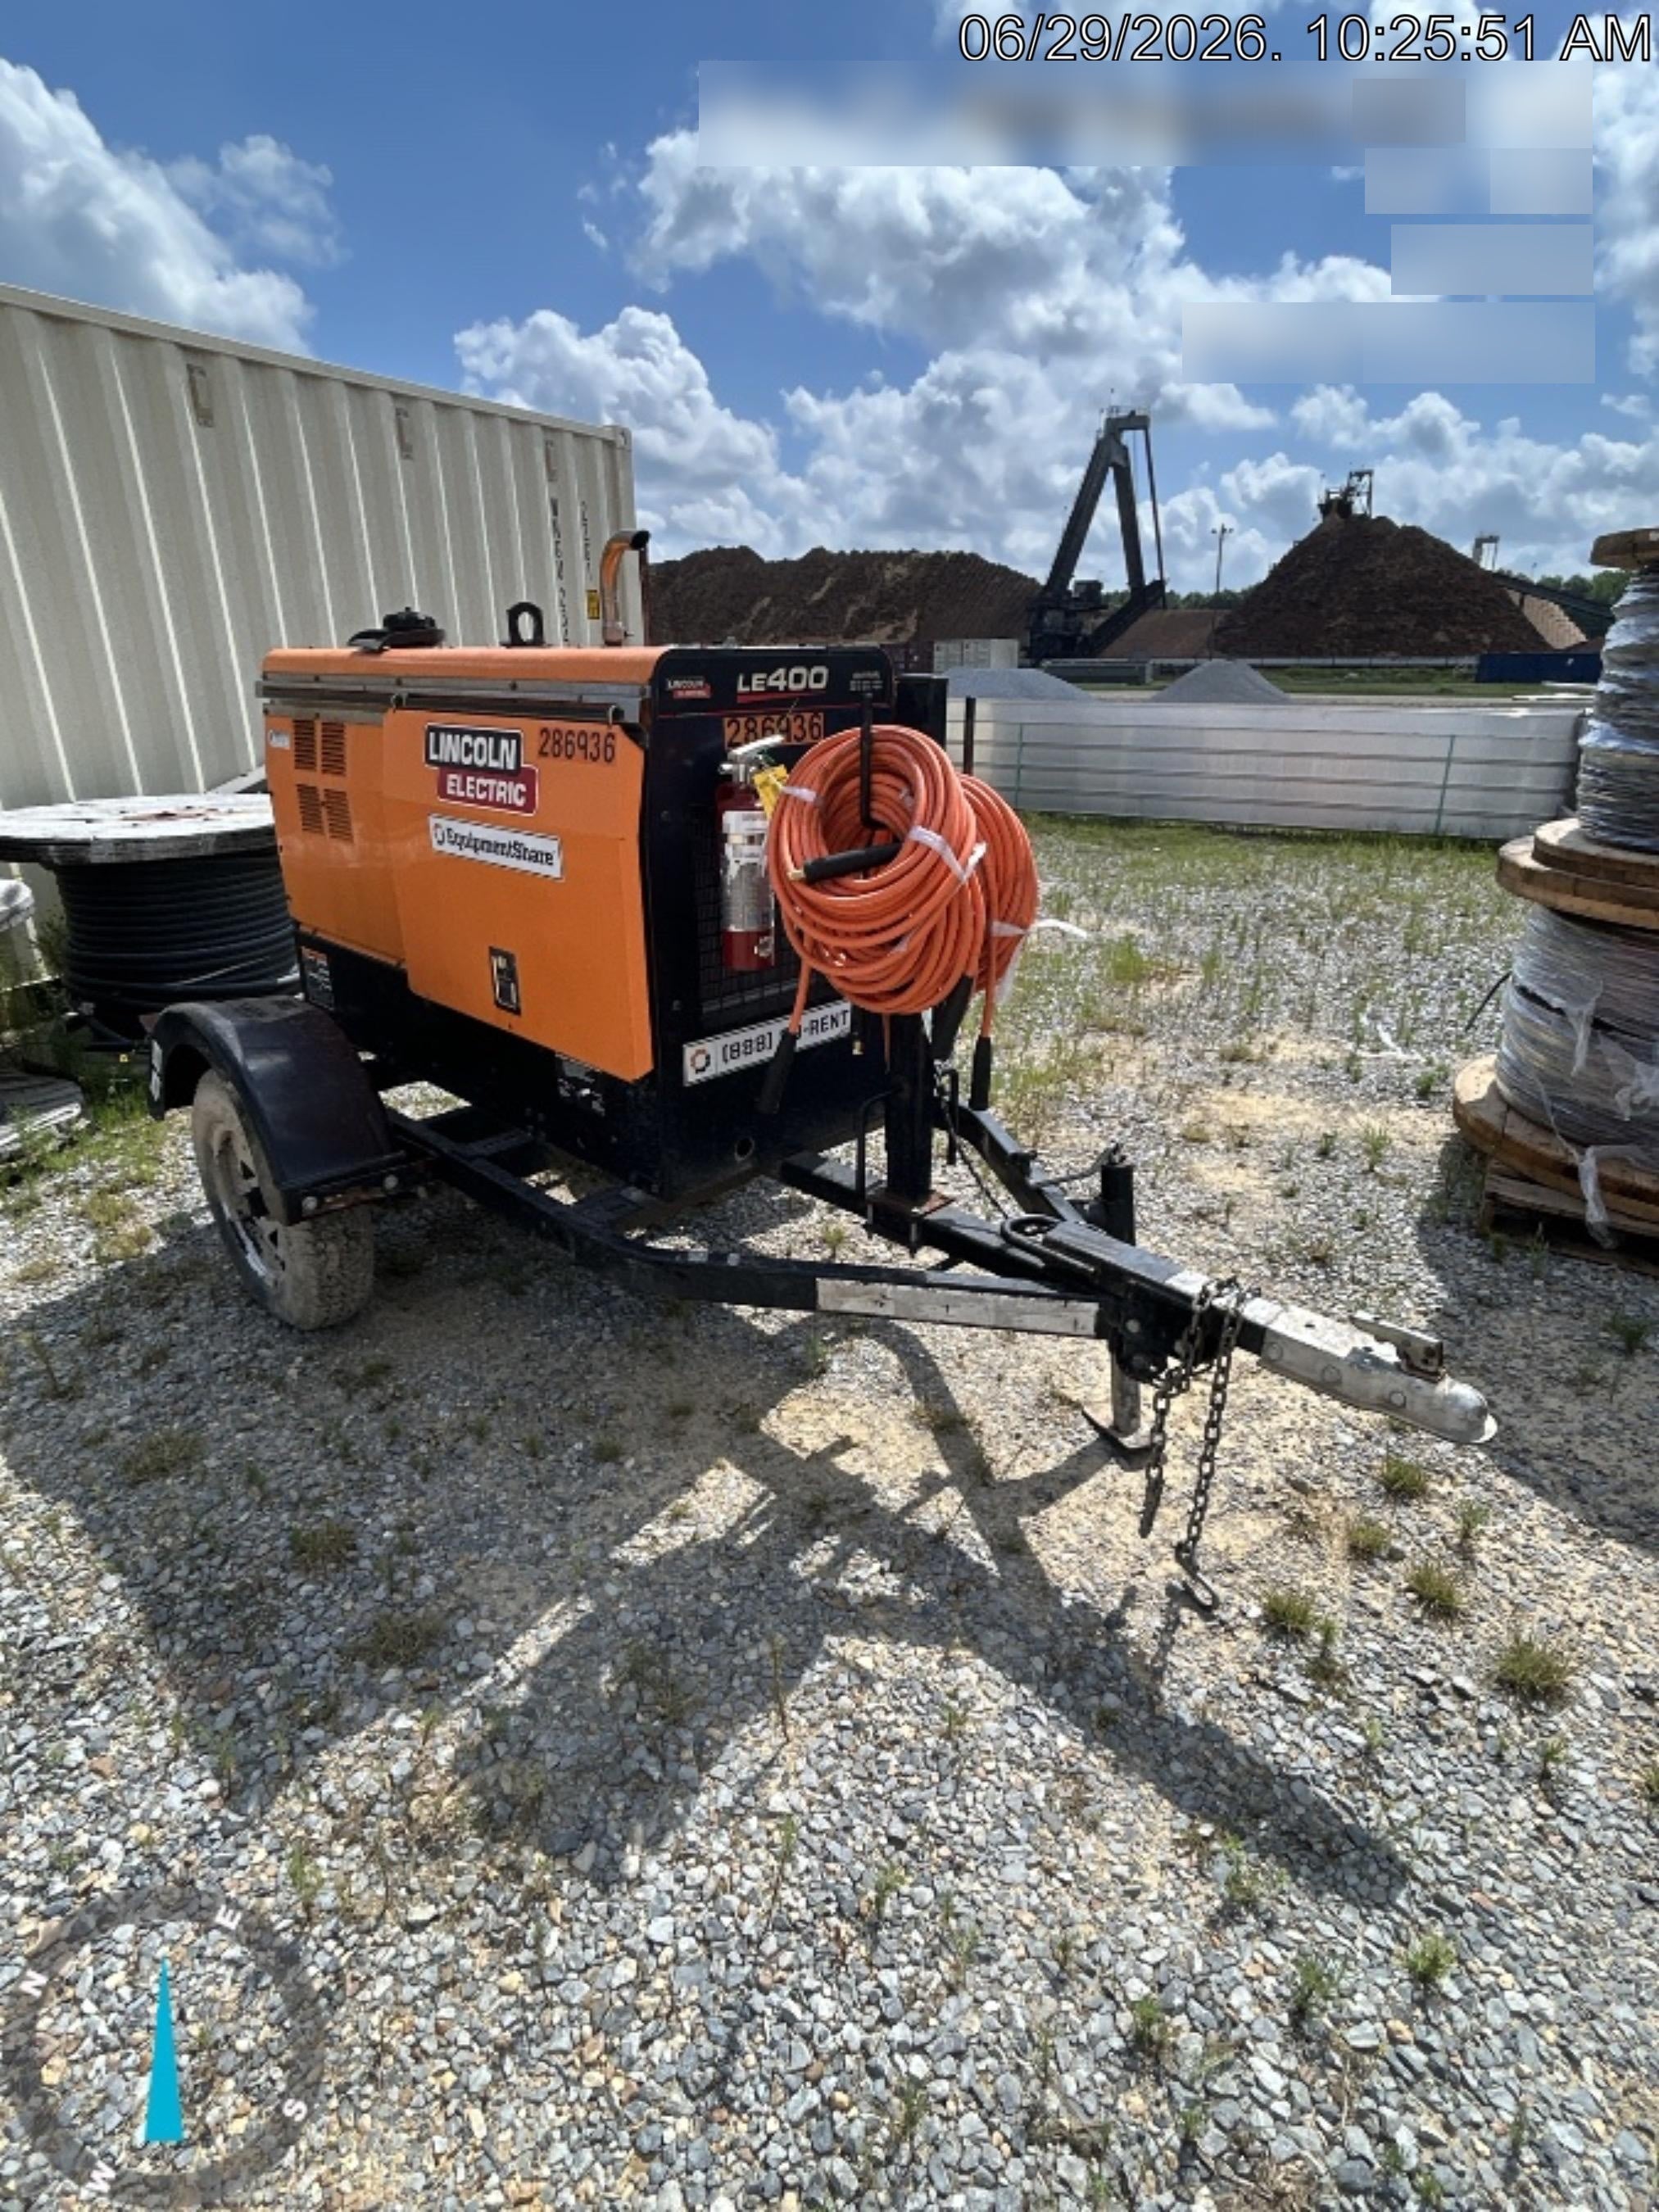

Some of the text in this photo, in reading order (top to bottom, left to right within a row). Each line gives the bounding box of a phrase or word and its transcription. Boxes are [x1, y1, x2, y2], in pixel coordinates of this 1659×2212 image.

[737, 665, 829, 693] LE400
[538, 728, 616, 764] 286936
[726, 714, 823, 746] 286936
[428, 732, 517, 770] LINCOLN
[446, 773, 527, 807] ELECTRIC
[446, 827, 554, 866] EquipmentShare
